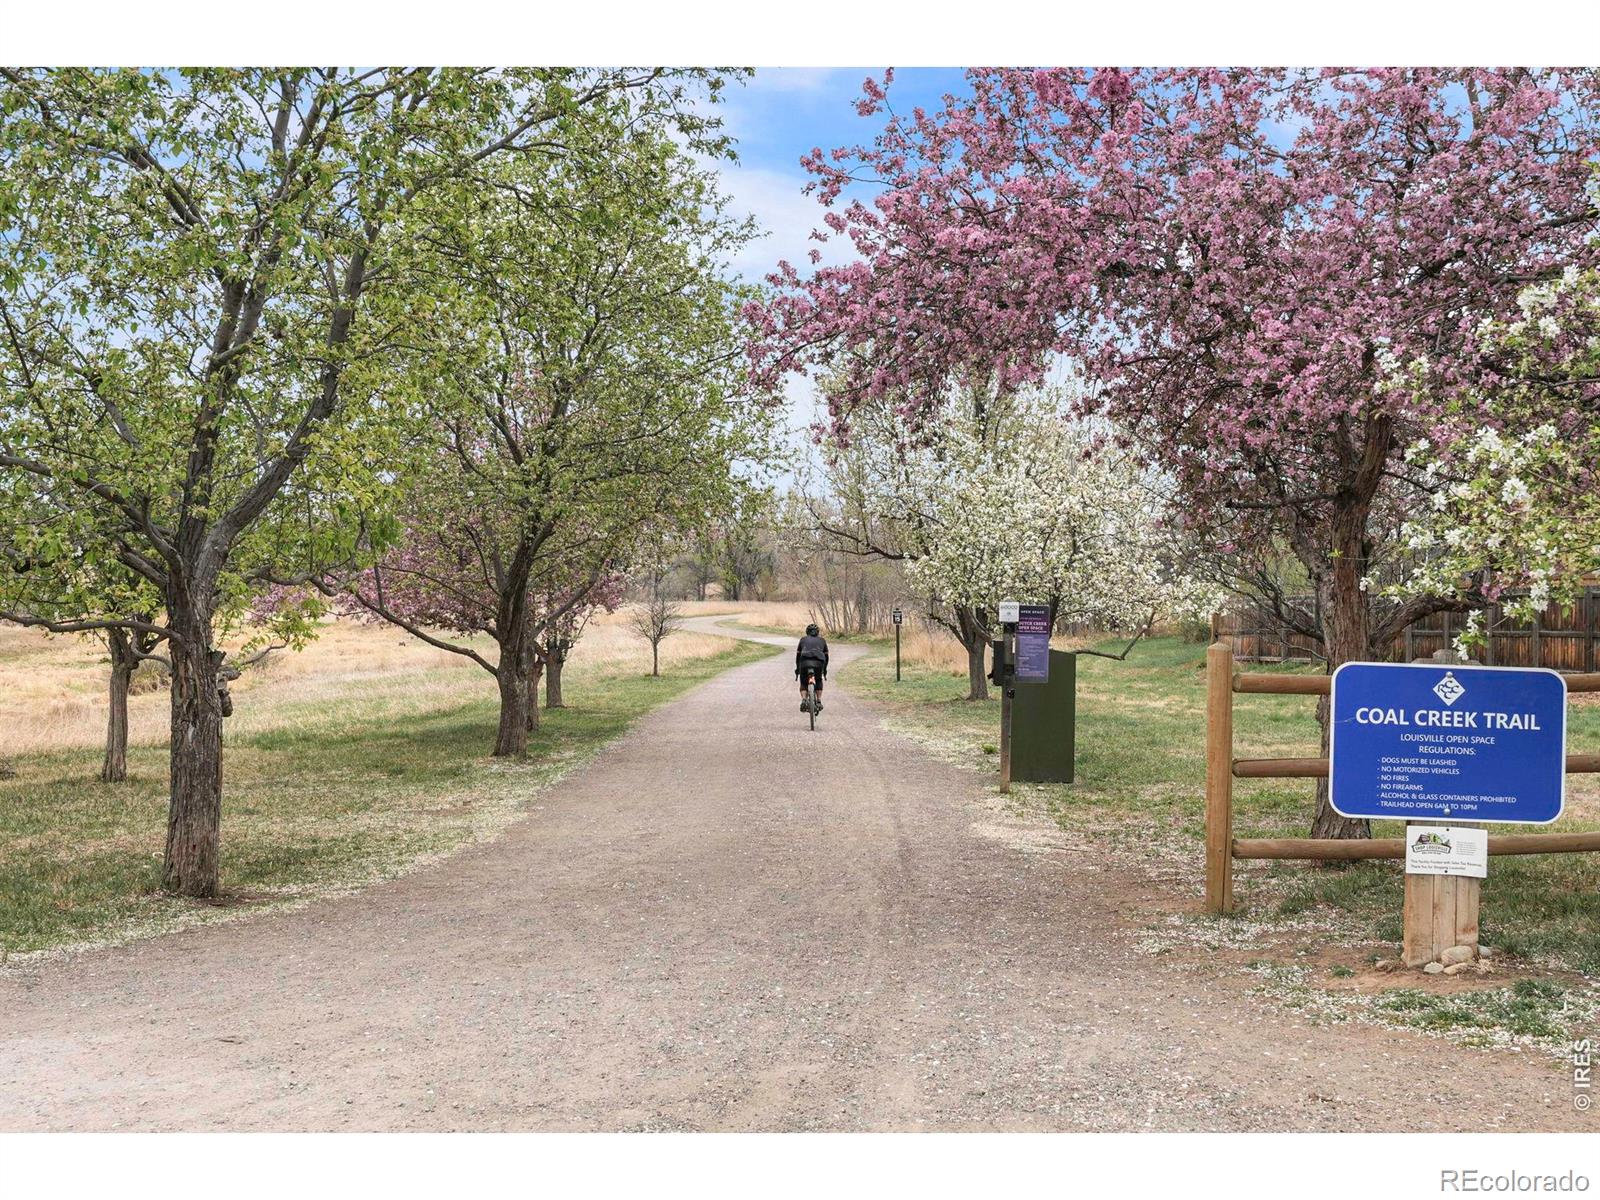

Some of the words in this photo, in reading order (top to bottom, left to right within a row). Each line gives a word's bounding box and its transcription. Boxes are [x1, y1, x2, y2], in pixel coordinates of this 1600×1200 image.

[1356, 708, 1409, 725] COAL
[1414, 710, 1477, 728] CREEK
[1483, 712, 1540, 730] TRAIL
[1400, 734, 1444, 742] LOUISVILLE
[1471, 736, 1495, 744] SPACE
[1419, 746, 1476, 756] REGULATIONS:
